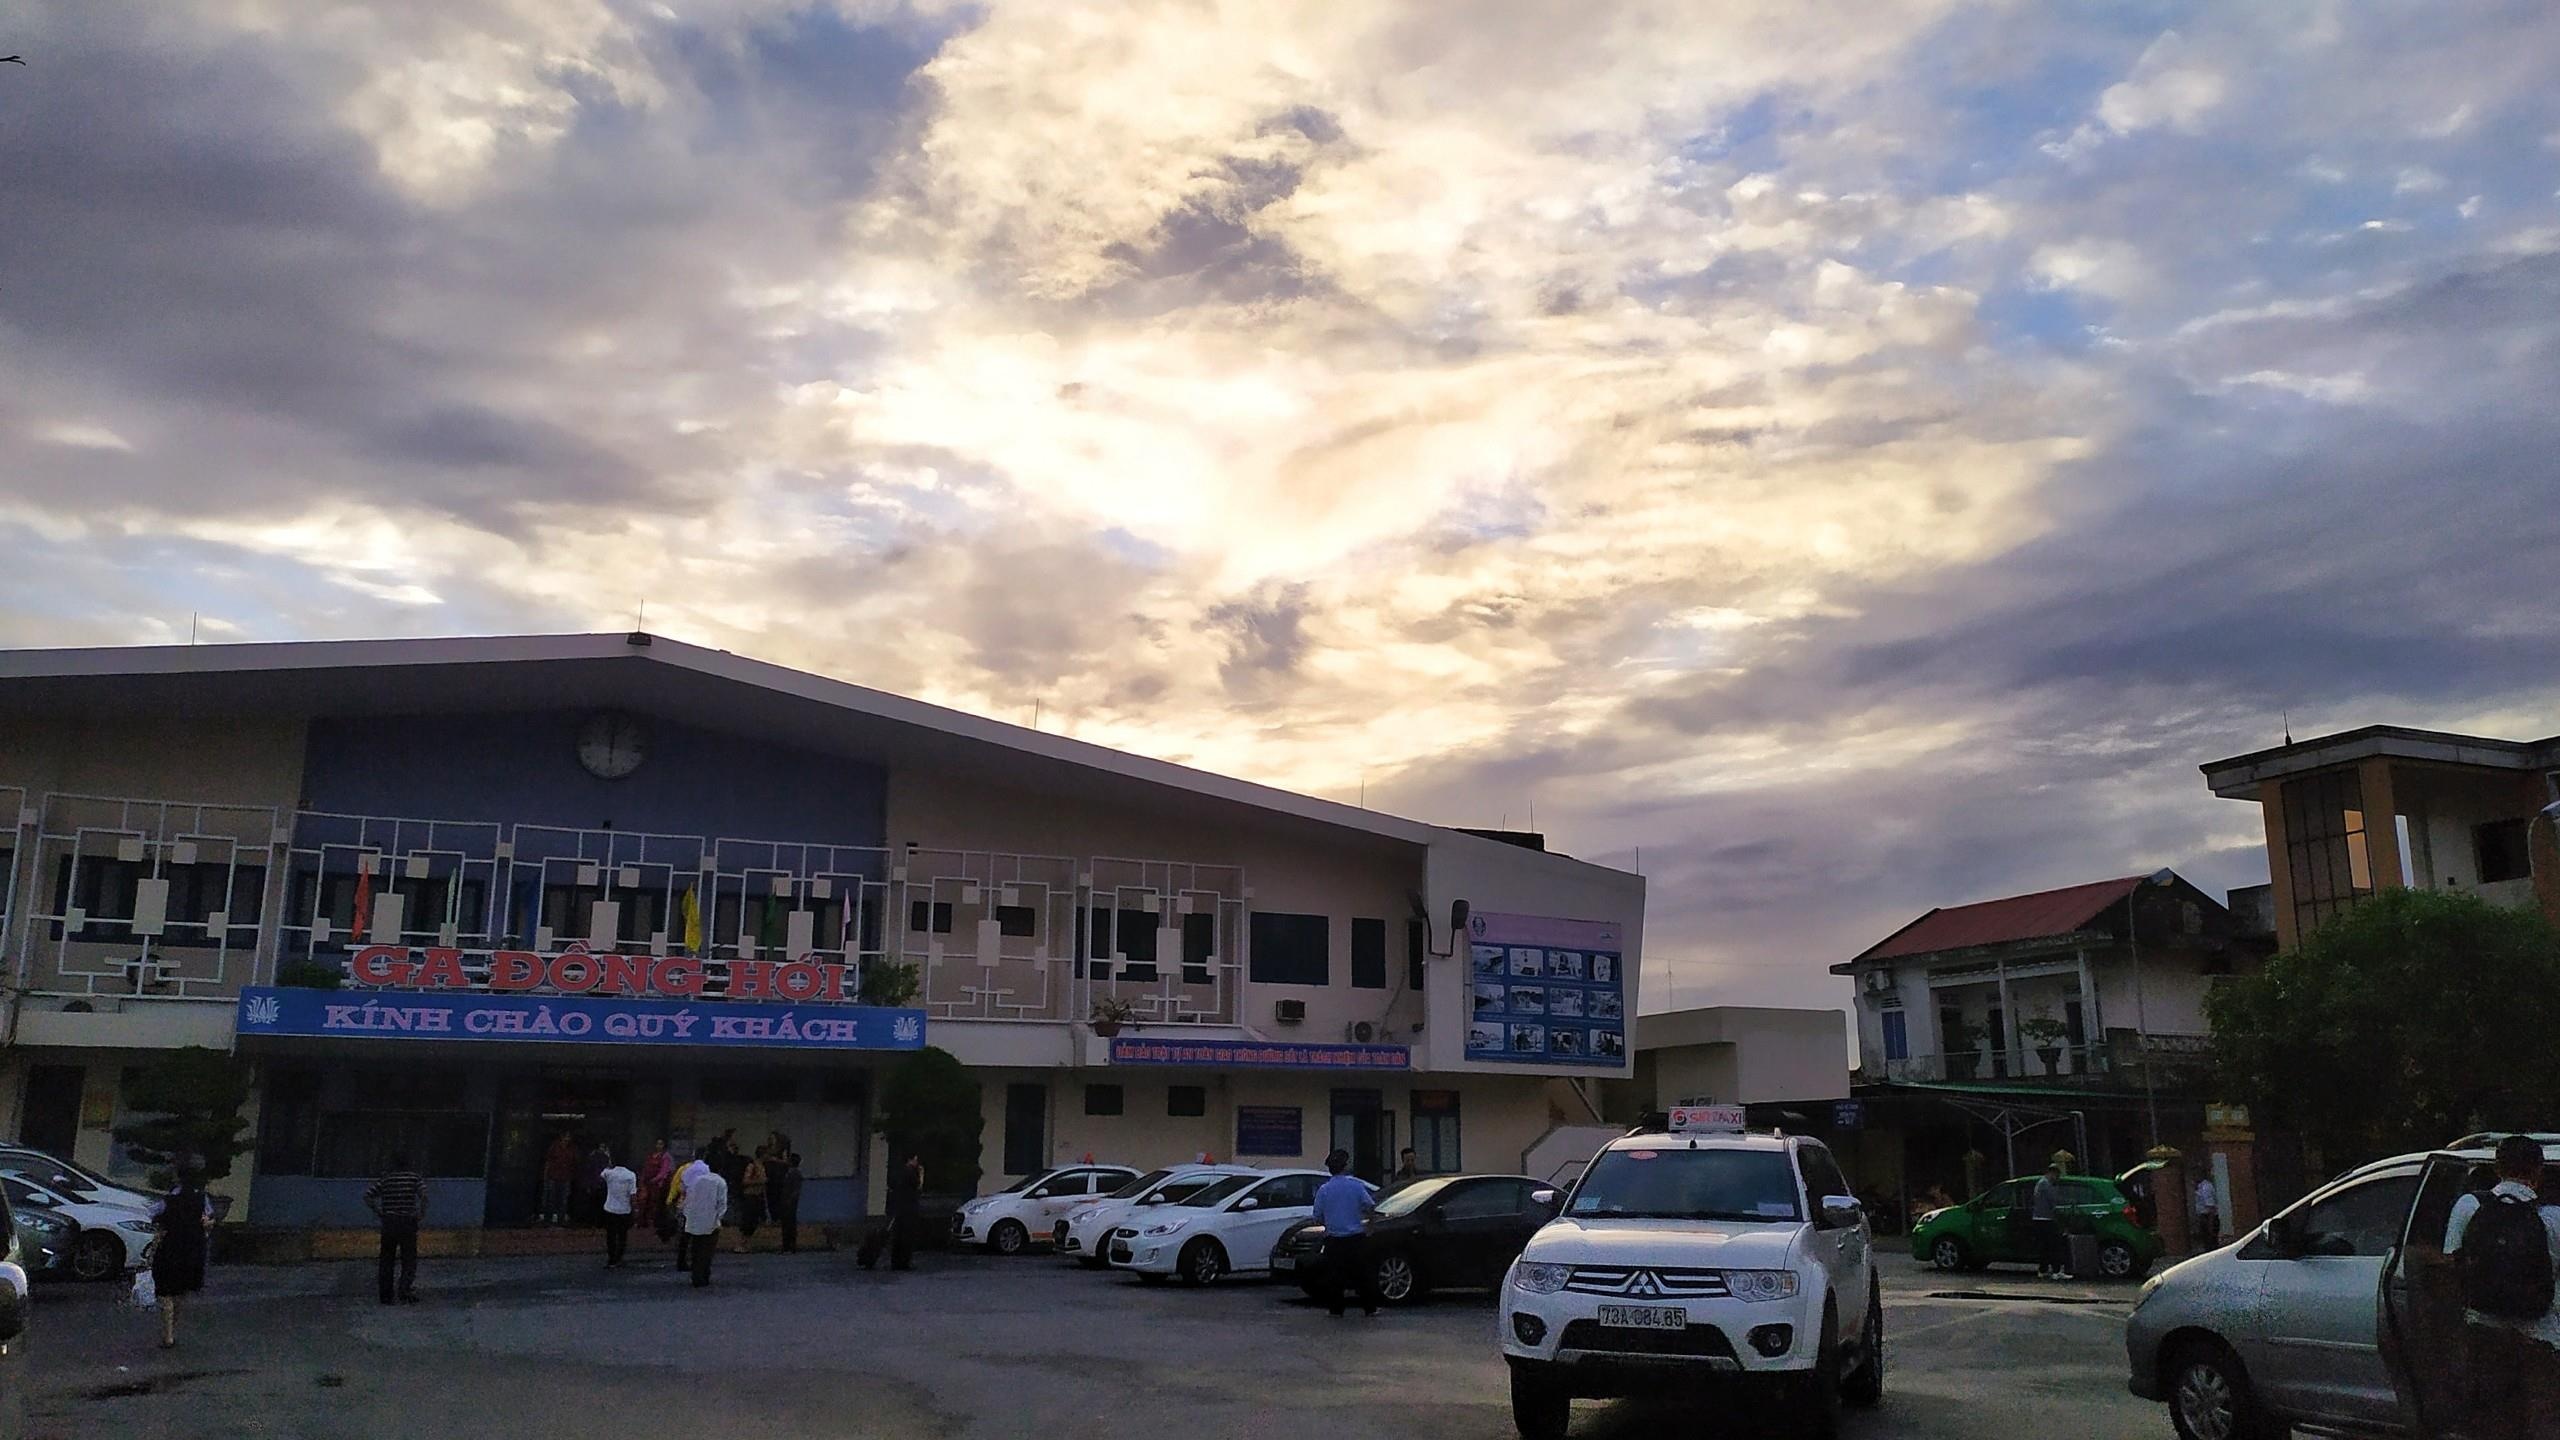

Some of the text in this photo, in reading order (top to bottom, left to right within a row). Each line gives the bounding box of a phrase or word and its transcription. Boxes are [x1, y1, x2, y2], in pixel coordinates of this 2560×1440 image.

[352, 939, 846, 1000] GA ĐỒNG HỚI
[323, 999, 857, 1041] KÍNH CHÀO QUÝ KHÁCH
